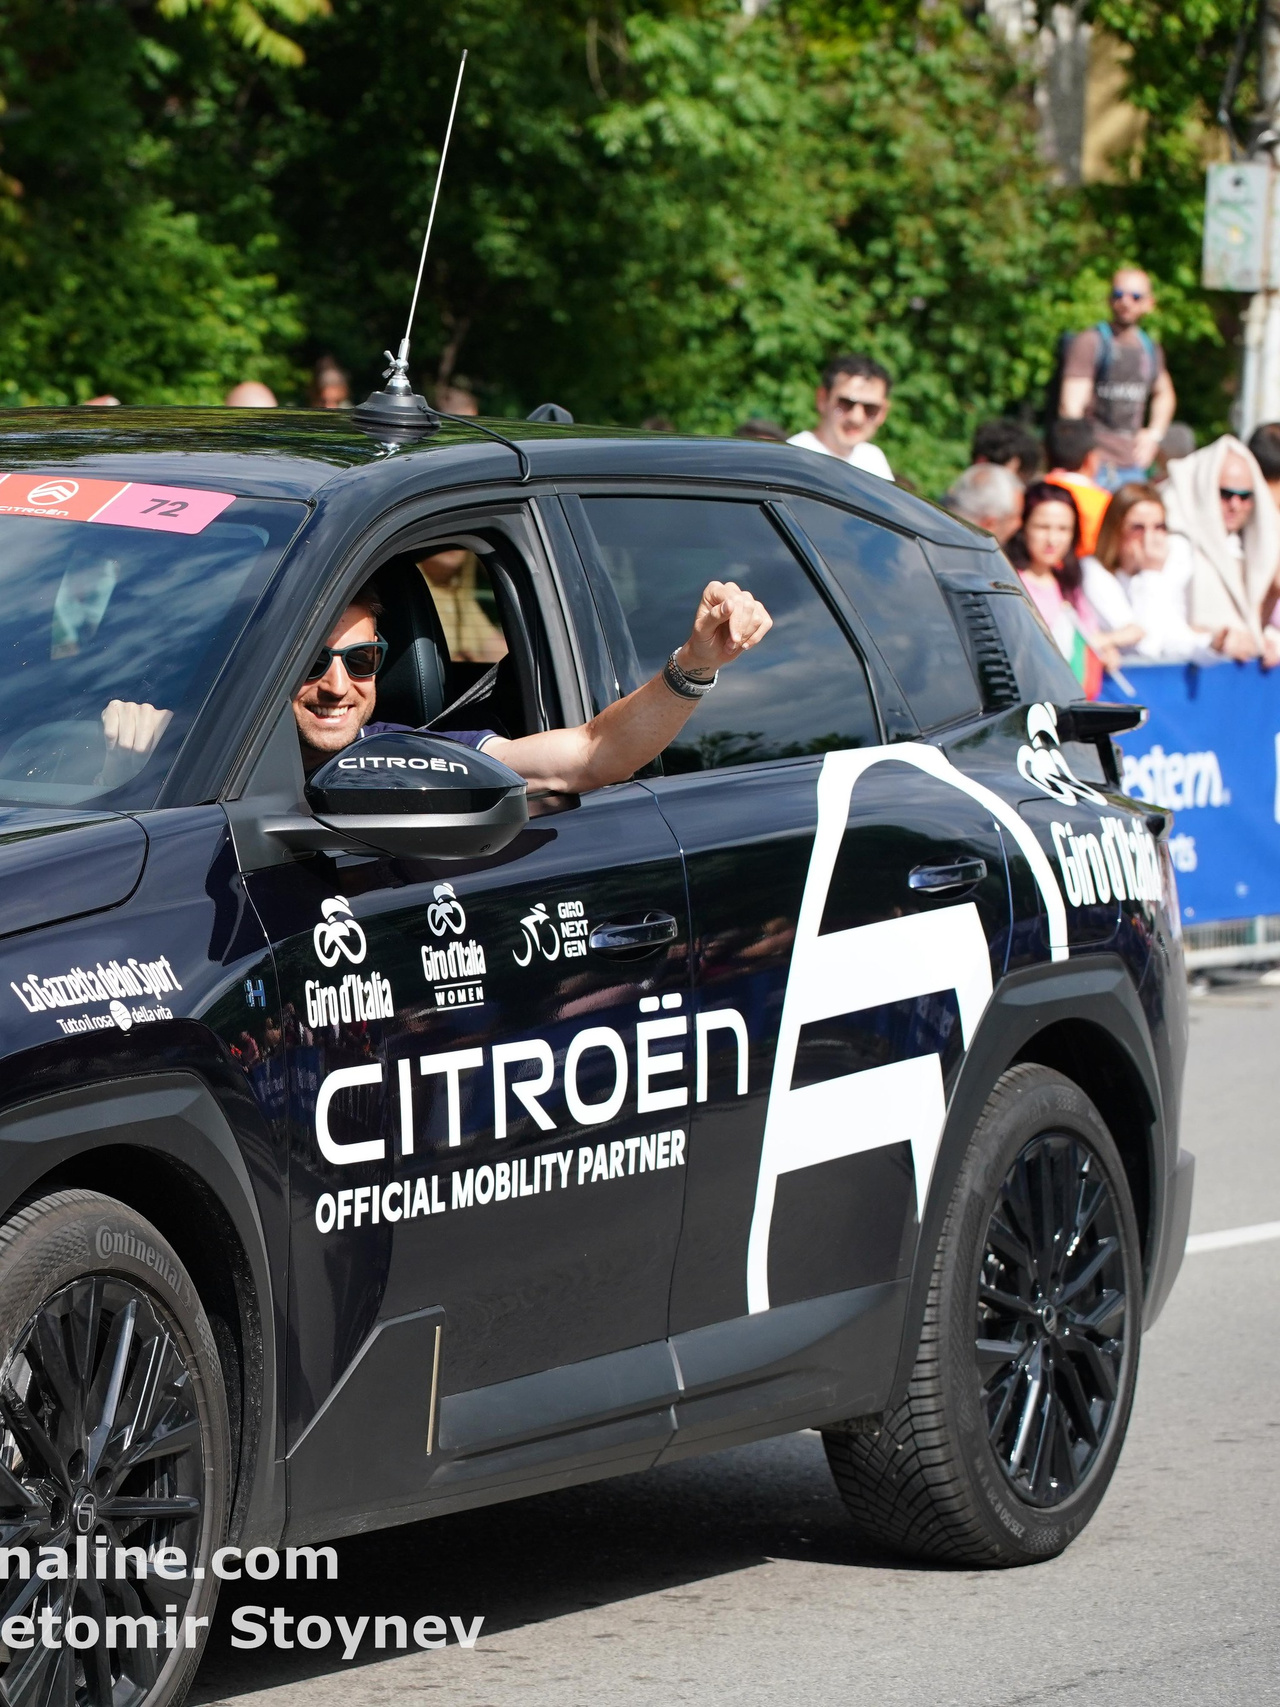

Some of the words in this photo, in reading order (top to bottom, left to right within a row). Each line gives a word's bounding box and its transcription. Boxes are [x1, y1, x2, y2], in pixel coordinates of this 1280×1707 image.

[139, 498, 191, 518] 72
[1122, 744, 1226, 811] estern
[1050, 821, 1111, 907] Giro
[557, 900, 585, 919] GIRO
[560, 920, 590, 938] NEXT
[421, 945, 448, 982] Giro
[447, 939, 487, 977] d'Italia
[563, 939, 588, 958] GEN
[305, 979, 340, 1029] Giro
[339, 971, 394, 1023] d'Italia
[435, 986, 484, 1006] WOMEN
[131, 1006, 155, 1023] della
[153, 1004, 173, 1020] vita
[315, 1175, 446, 1234] OFFICIAL
[451, 1149, 574, 1210] MOBILITY
[577, 1129, 686, 1185] PARTNER
[95, 1225, 183, 1296] Continental
